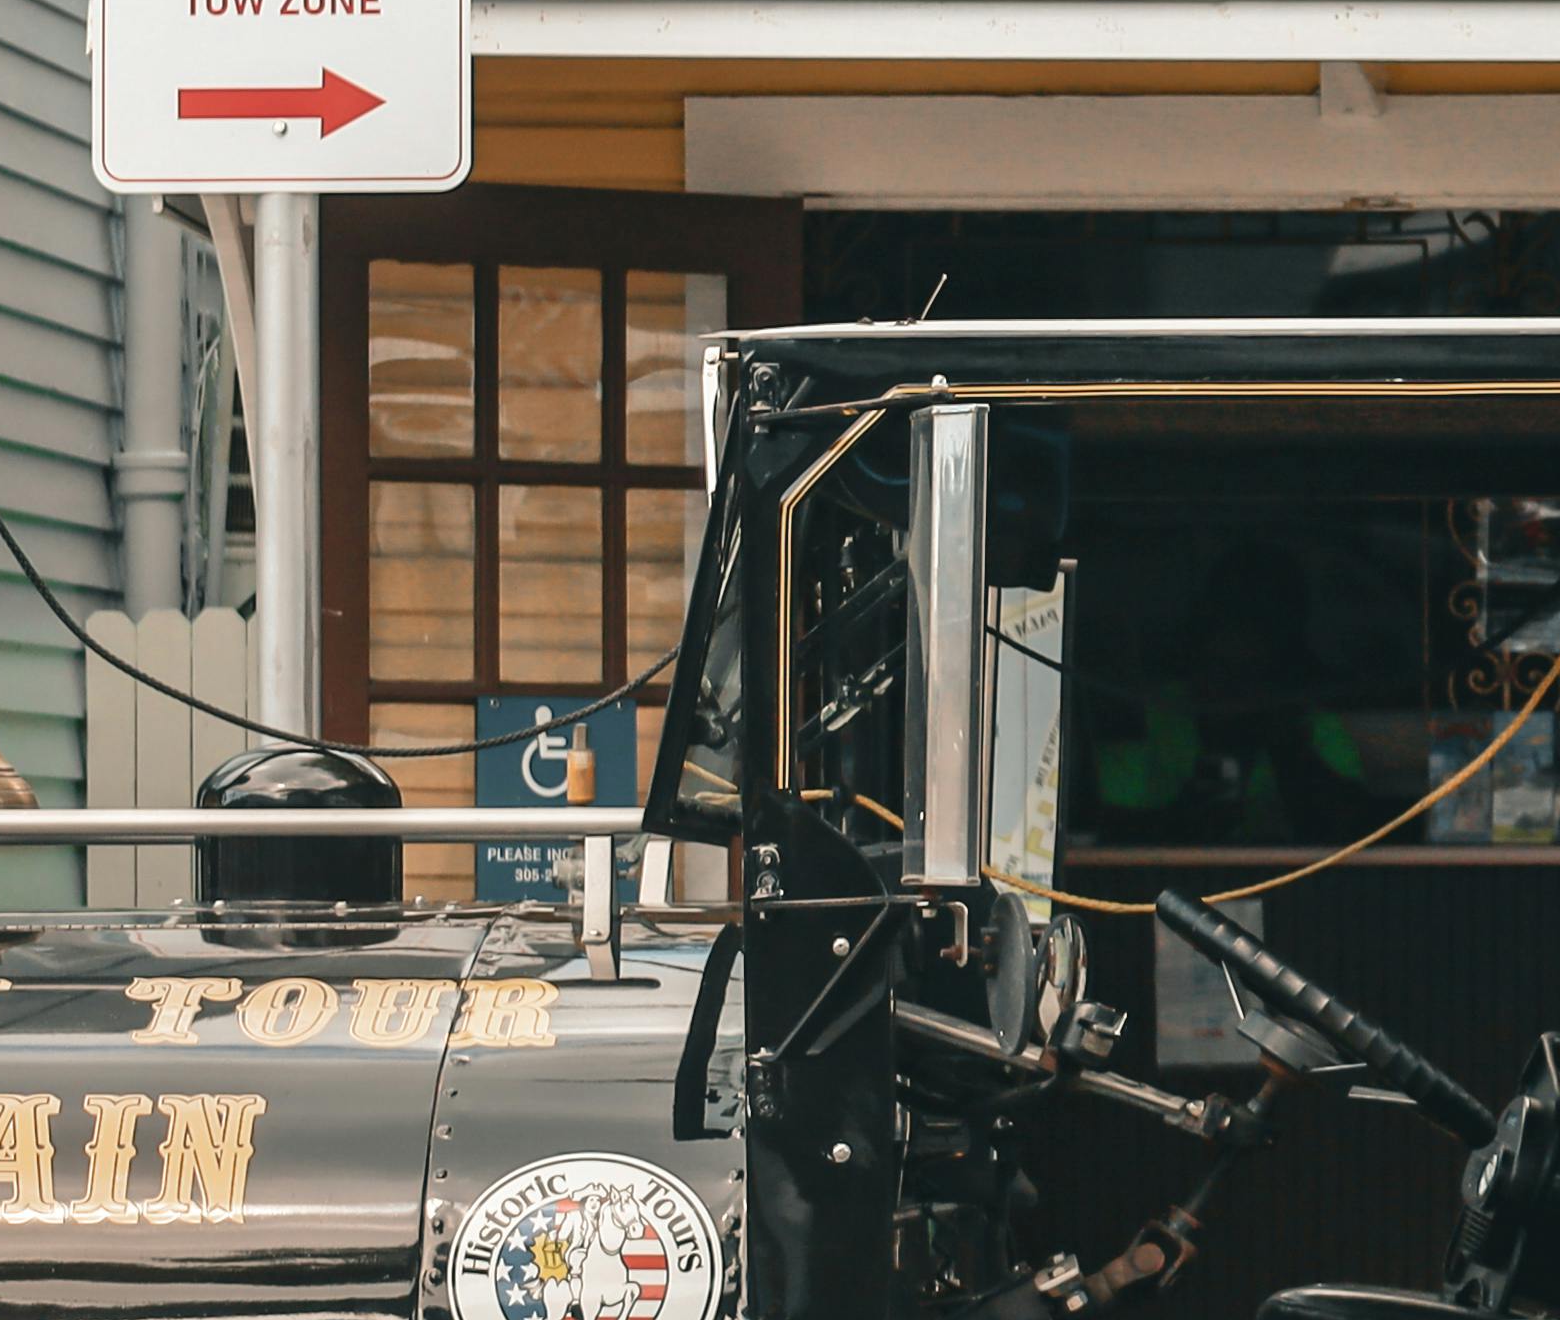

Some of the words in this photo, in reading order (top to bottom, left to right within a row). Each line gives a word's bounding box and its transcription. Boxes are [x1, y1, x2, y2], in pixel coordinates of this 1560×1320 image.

[488, 848, 541, 861] PLEASE
[127, 977, 559, 1048] TOUR
[462, 1174, 569, 1276] Historic
[640, 1178, 703, 1273] Tours
